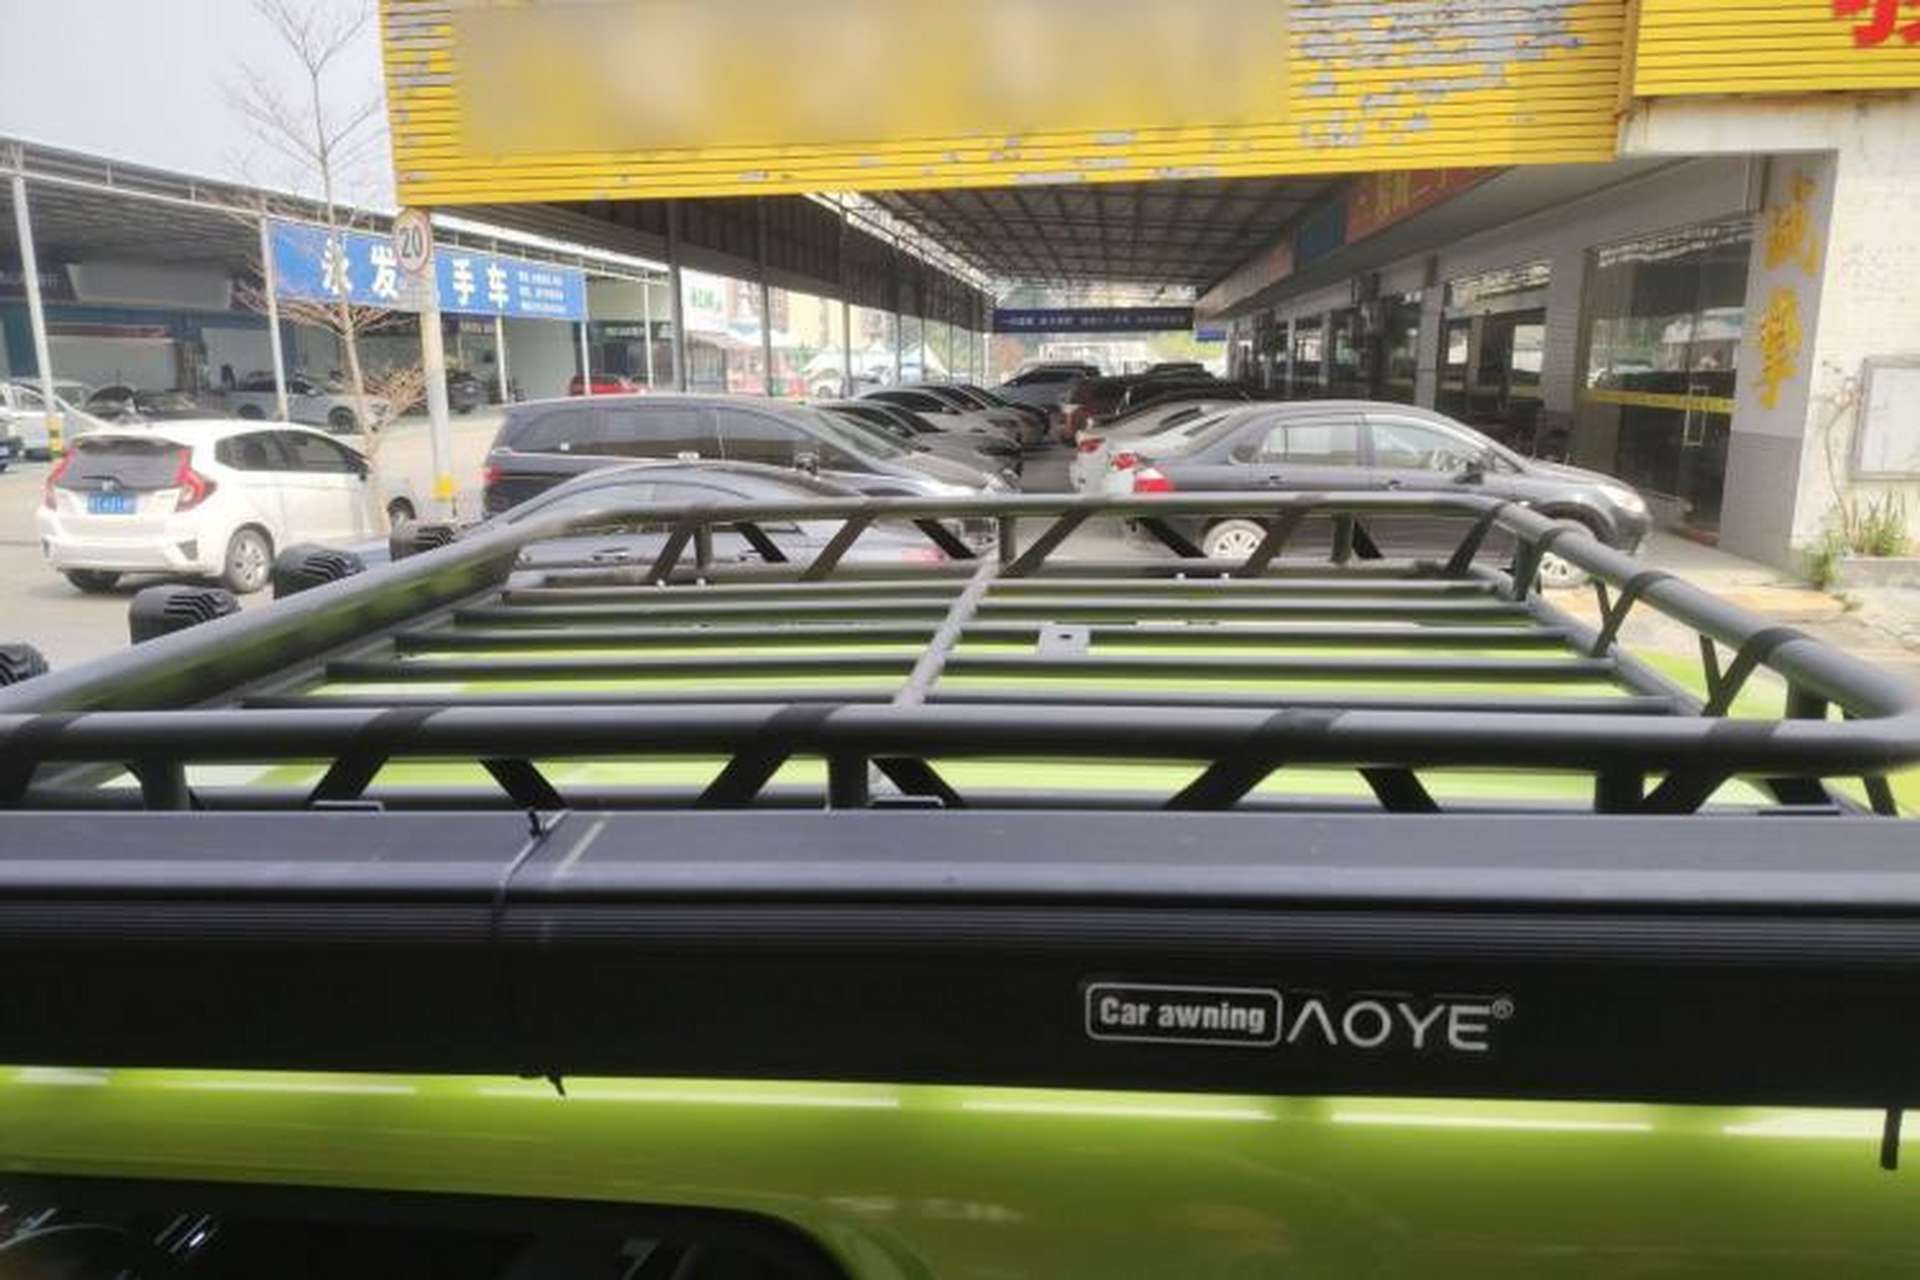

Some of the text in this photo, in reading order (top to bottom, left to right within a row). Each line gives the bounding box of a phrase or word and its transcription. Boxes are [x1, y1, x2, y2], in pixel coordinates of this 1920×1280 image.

[402, 228, 422, 258] 20
[1100, 996, 1265, 1034] Car awning
